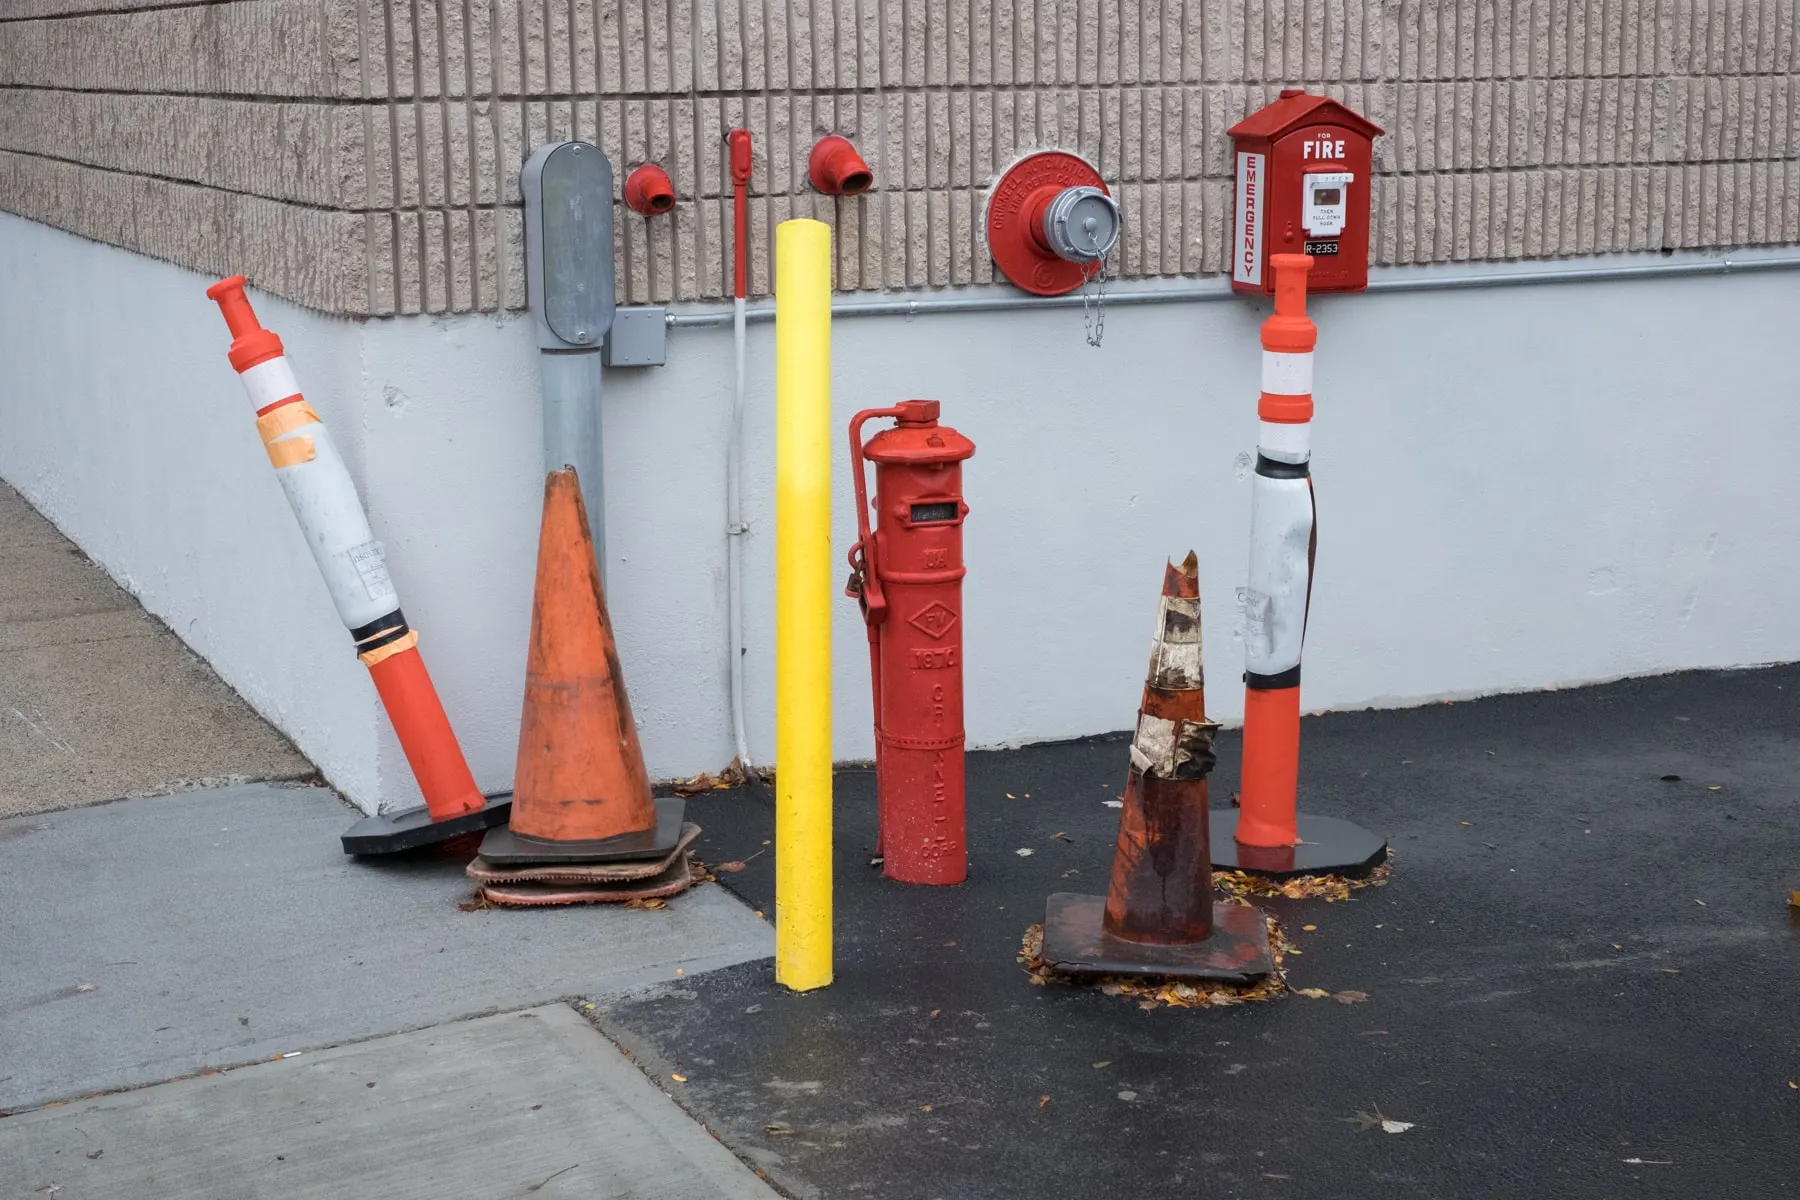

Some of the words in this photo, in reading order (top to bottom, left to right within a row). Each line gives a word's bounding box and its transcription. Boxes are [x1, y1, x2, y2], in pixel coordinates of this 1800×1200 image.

[1303, 140, 1345, 159] FIRE
[992, 176, 1022, 230] GRINNELL
[1009, 187, 1028, 214] FIRE
[1244, 156, 1257, 278] EMERGENCY
[1306, 243, 1339, 254] R-2353
[915, 649, 957, 668] 1970
